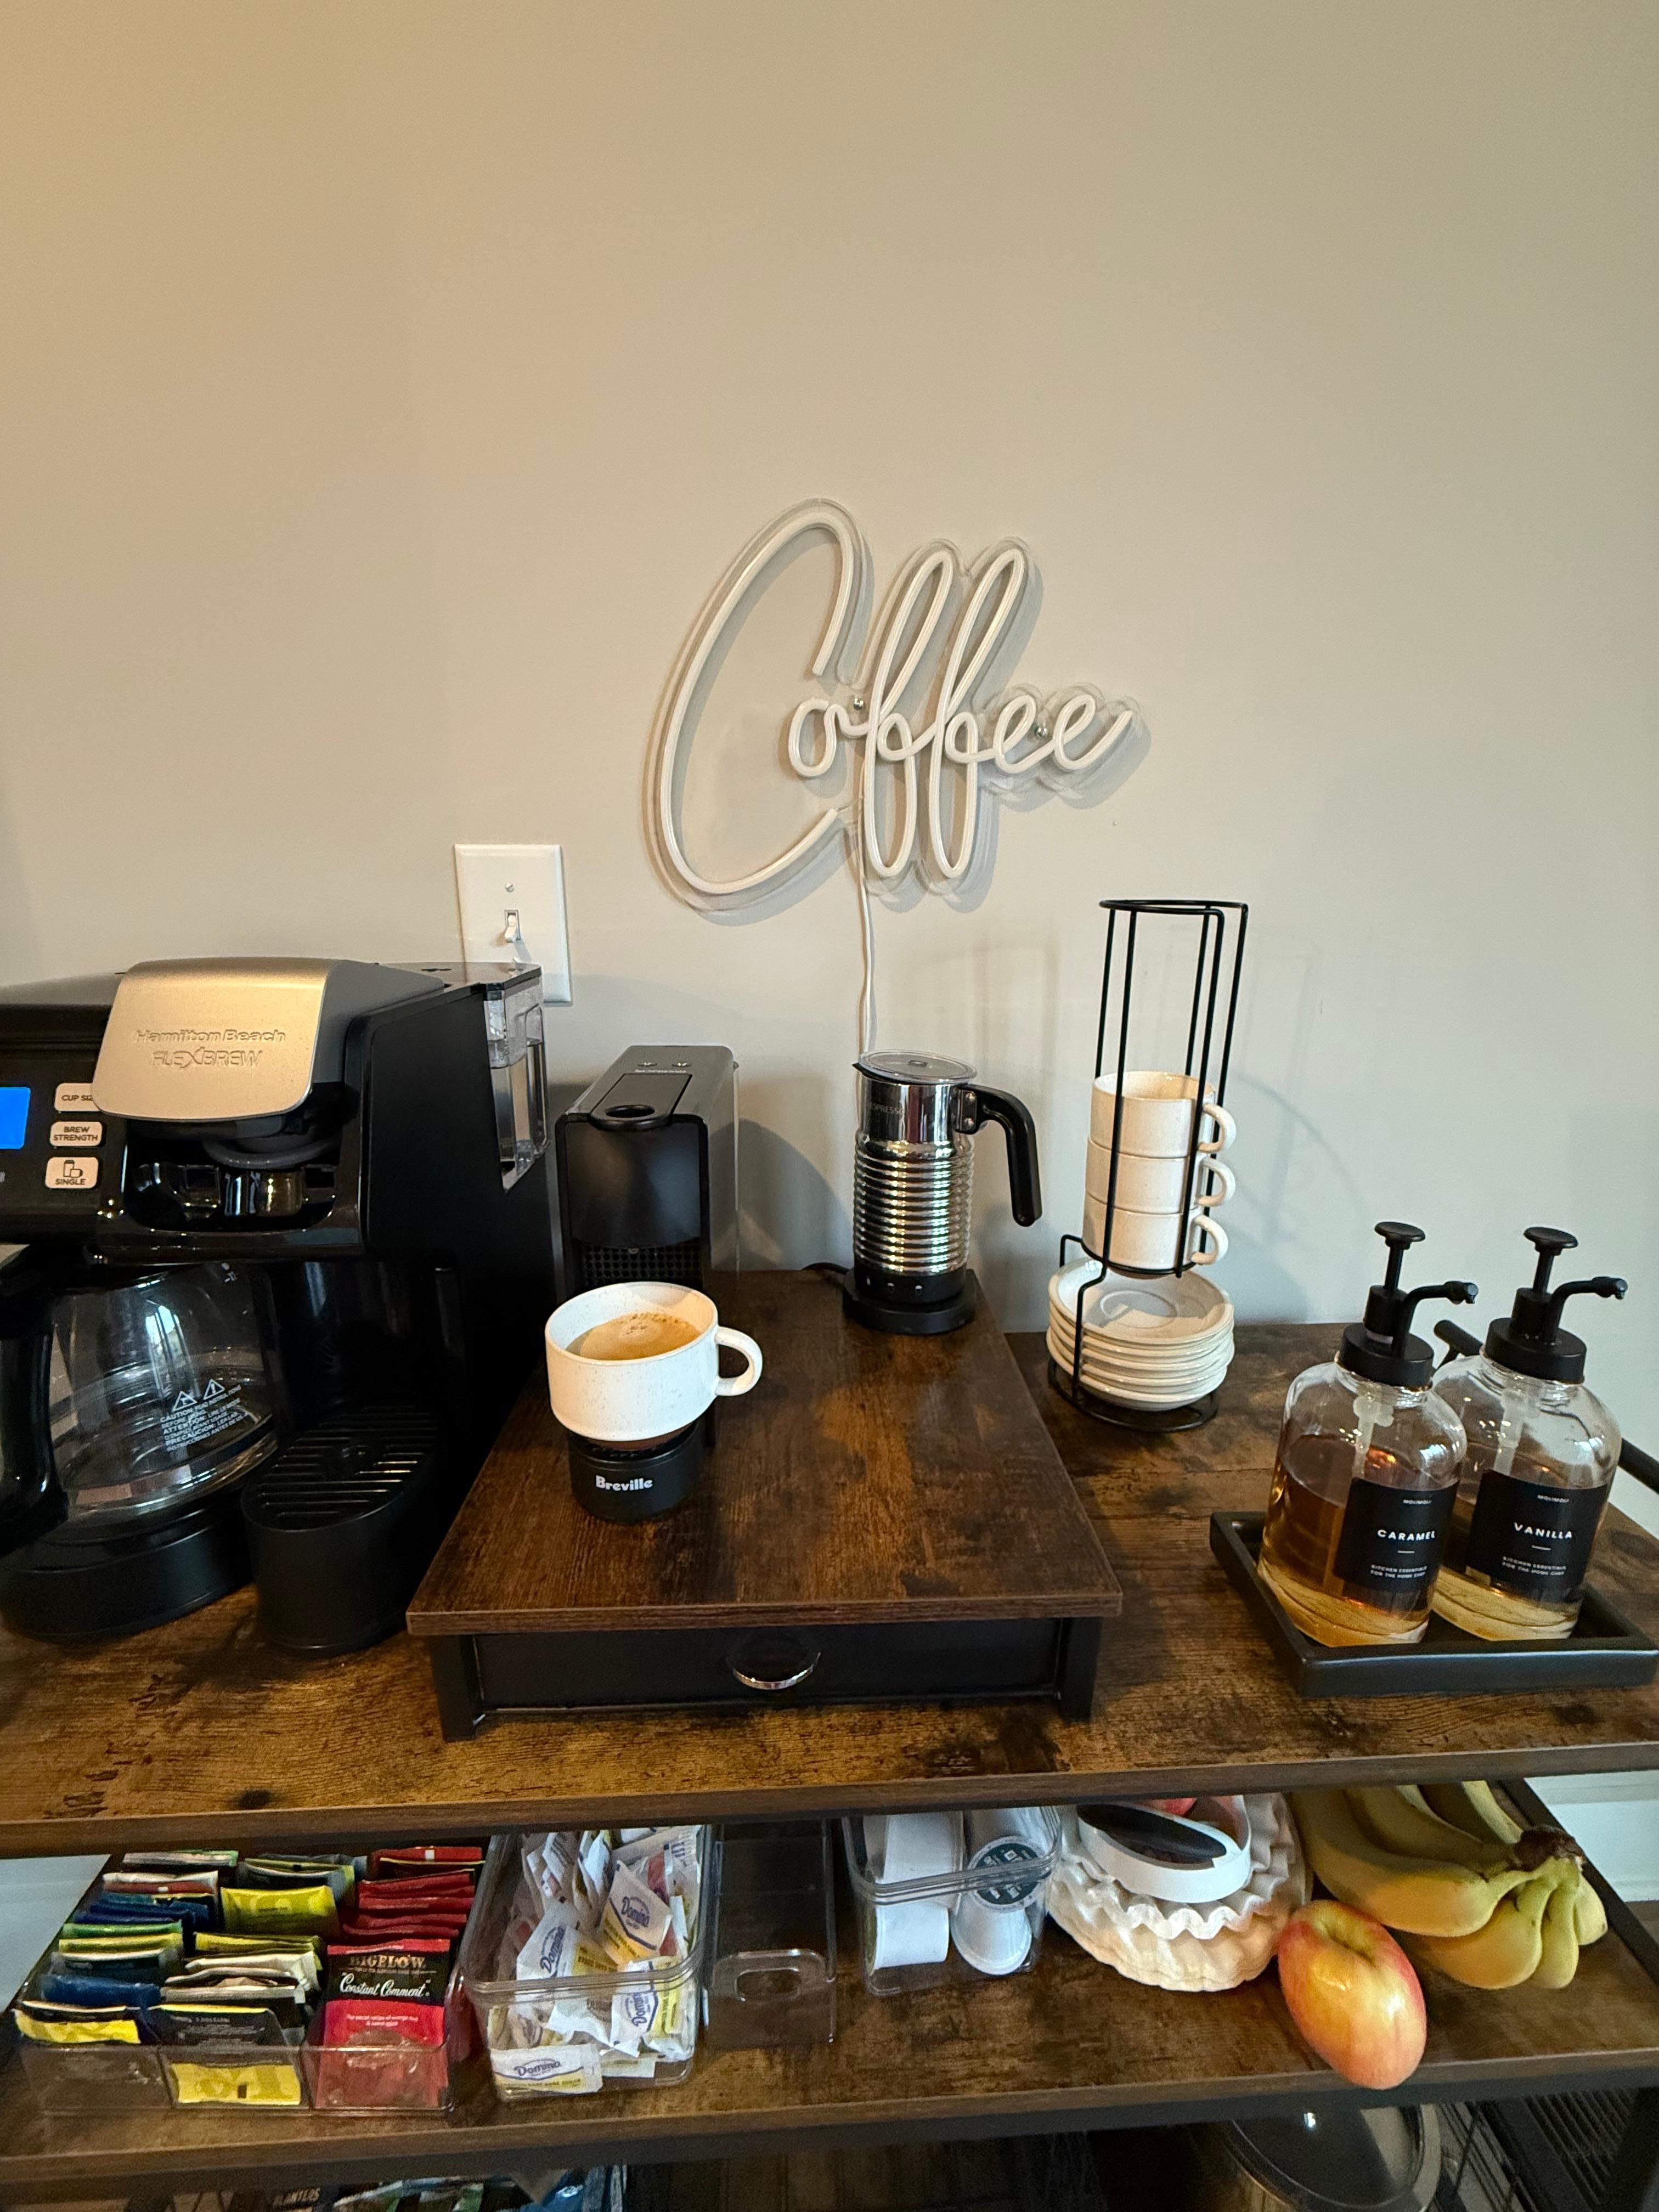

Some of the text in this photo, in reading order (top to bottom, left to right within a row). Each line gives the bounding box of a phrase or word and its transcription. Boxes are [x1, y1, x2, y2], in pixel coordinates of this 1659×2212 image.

[659, 510, 1133, 893] Coffee
[136, 1029, 286, 1042] Hamilton Beach
[153, 1047, 263, 1068] FLEXBREW
[596, 1475, 653, 1491] Breville
[1377, 1529, 1436, 1541] CARAMEL
[1514, 1522, 1572, 1539] VANILLA
[620, 1896, 651, 1928] Domino
[540, 1925, 567, 1974] Domino
[631, 1993, 648, 2027] Domin
[513, 2061, 562, 2076] Domino
